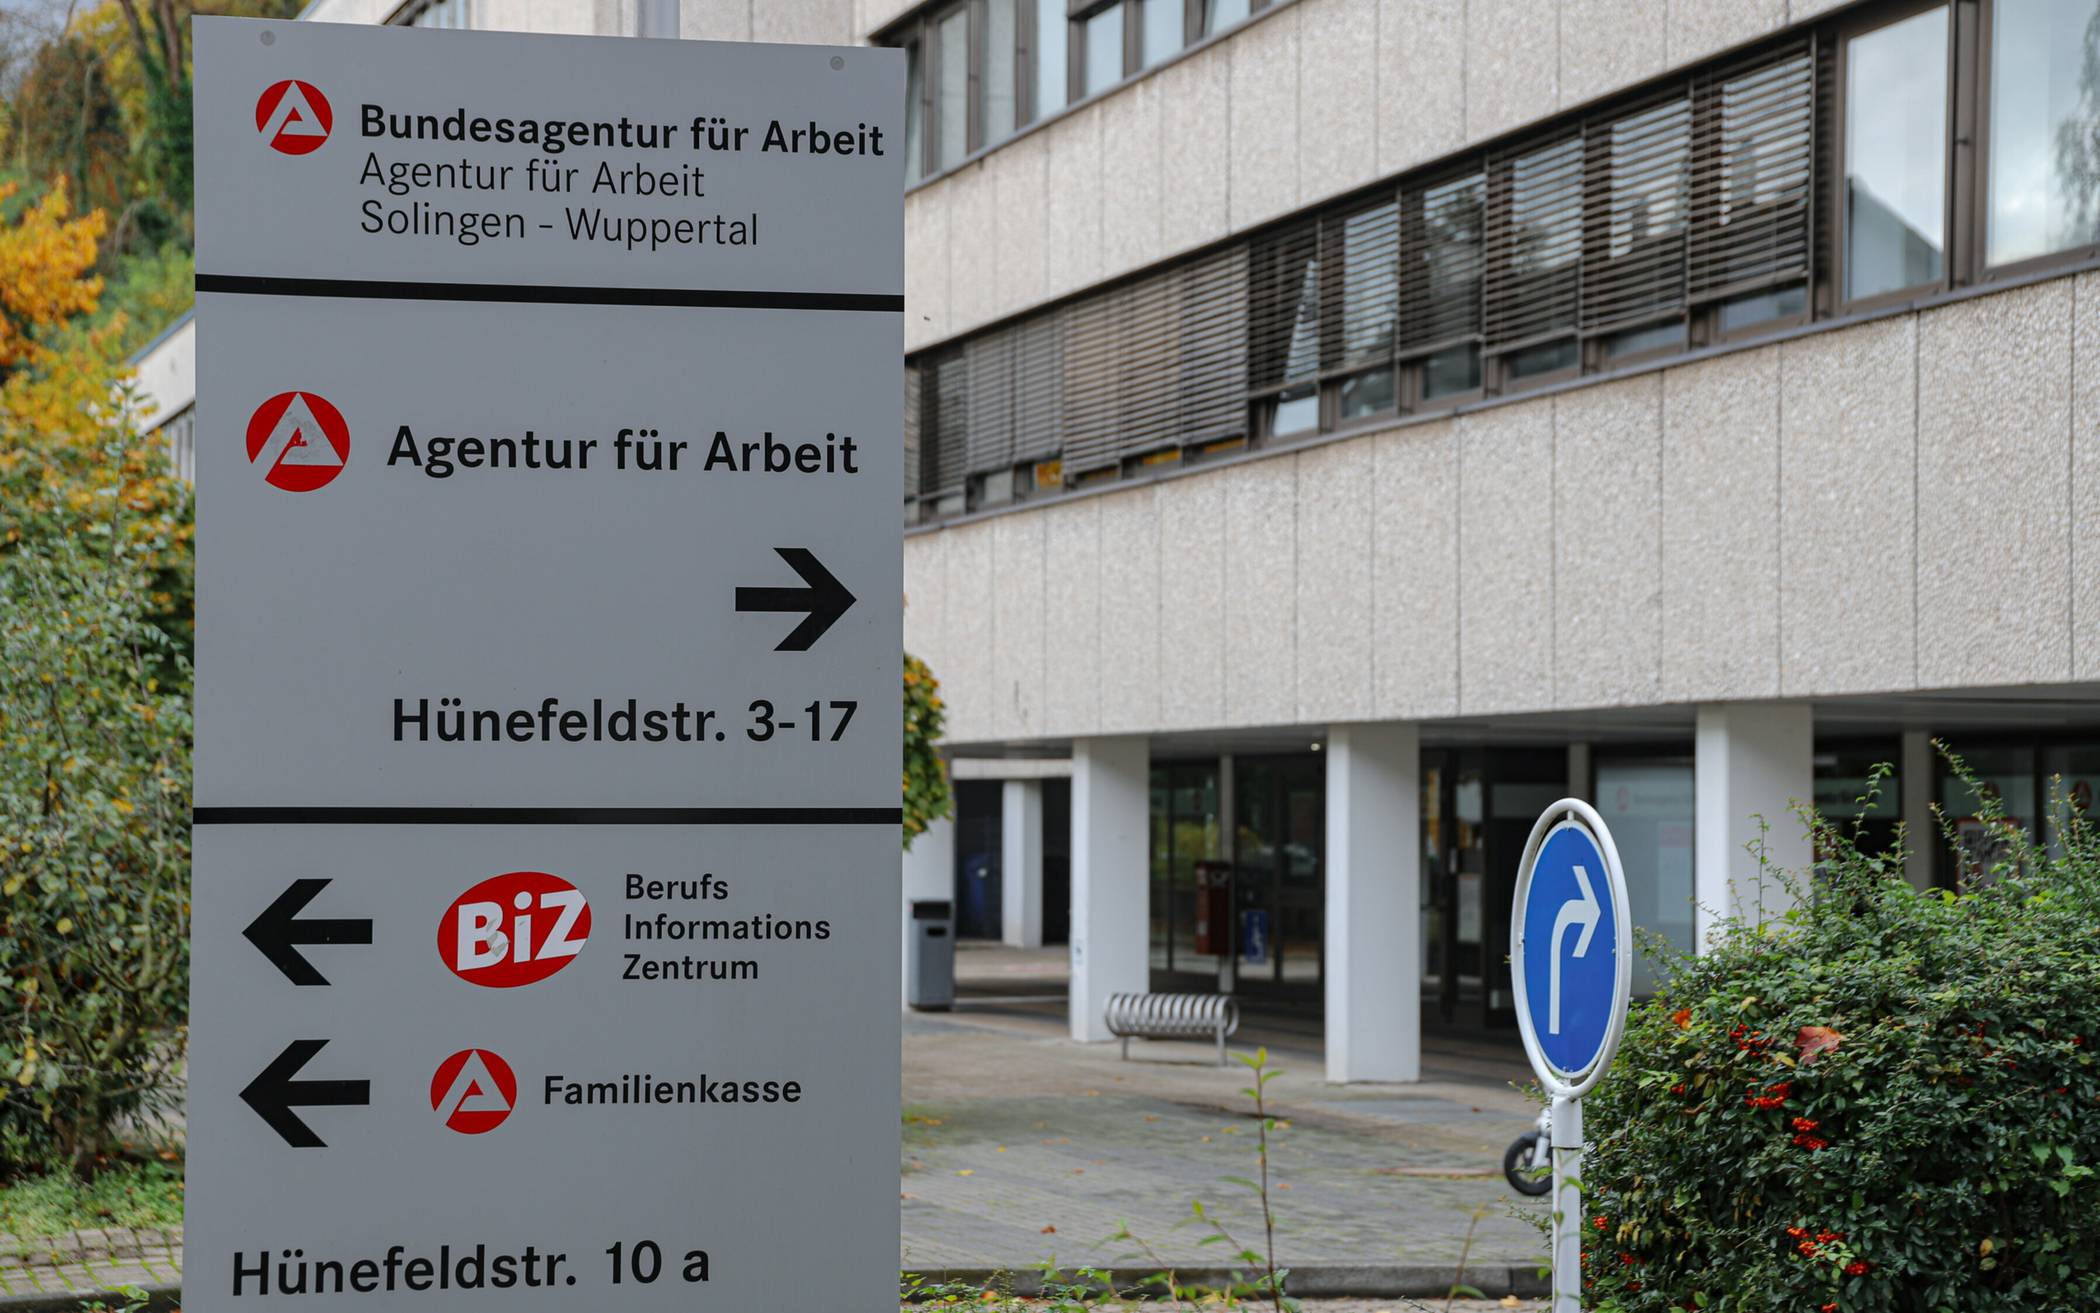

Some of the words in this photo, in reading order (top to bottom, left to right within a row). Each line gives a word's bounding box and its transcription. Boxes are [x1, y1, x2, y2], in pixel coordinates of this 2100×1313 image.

[361, 104, 678, 154] Bundesagentur
[690, 116, 749, 152] für
[761, 120, 885, 156] Arbeit
[360, 152, 514, 196] Agentur
[526, 157, 580, 193] für
[592, 161, 705, 198] Arbeit
[361, 199, 525, 247] Solingen
[565, 207, 757, 252] Wuppertal
[387, 425, 598, 480] Agentur
[614, 429, 688, 471] für
[704, 431, 858, 474] Arbeit
[394, 697, 726, 743] Hünefeldstr.
[746, 699, 858, 743] 3-17
[625, 873, 729, 901] Berufs
[457, 889, 587, 971] BiZ
[625, 912, 830, 941] Informations
[622, 954, 758, 981] Zentrum
[544, 1073, 801, 1105] Familienkasse
[232, 1244, 577, 1296] Hünefeldstr.
[605, 1240, 663, 1285] 10
[682, 1250, 710, 1284] a
